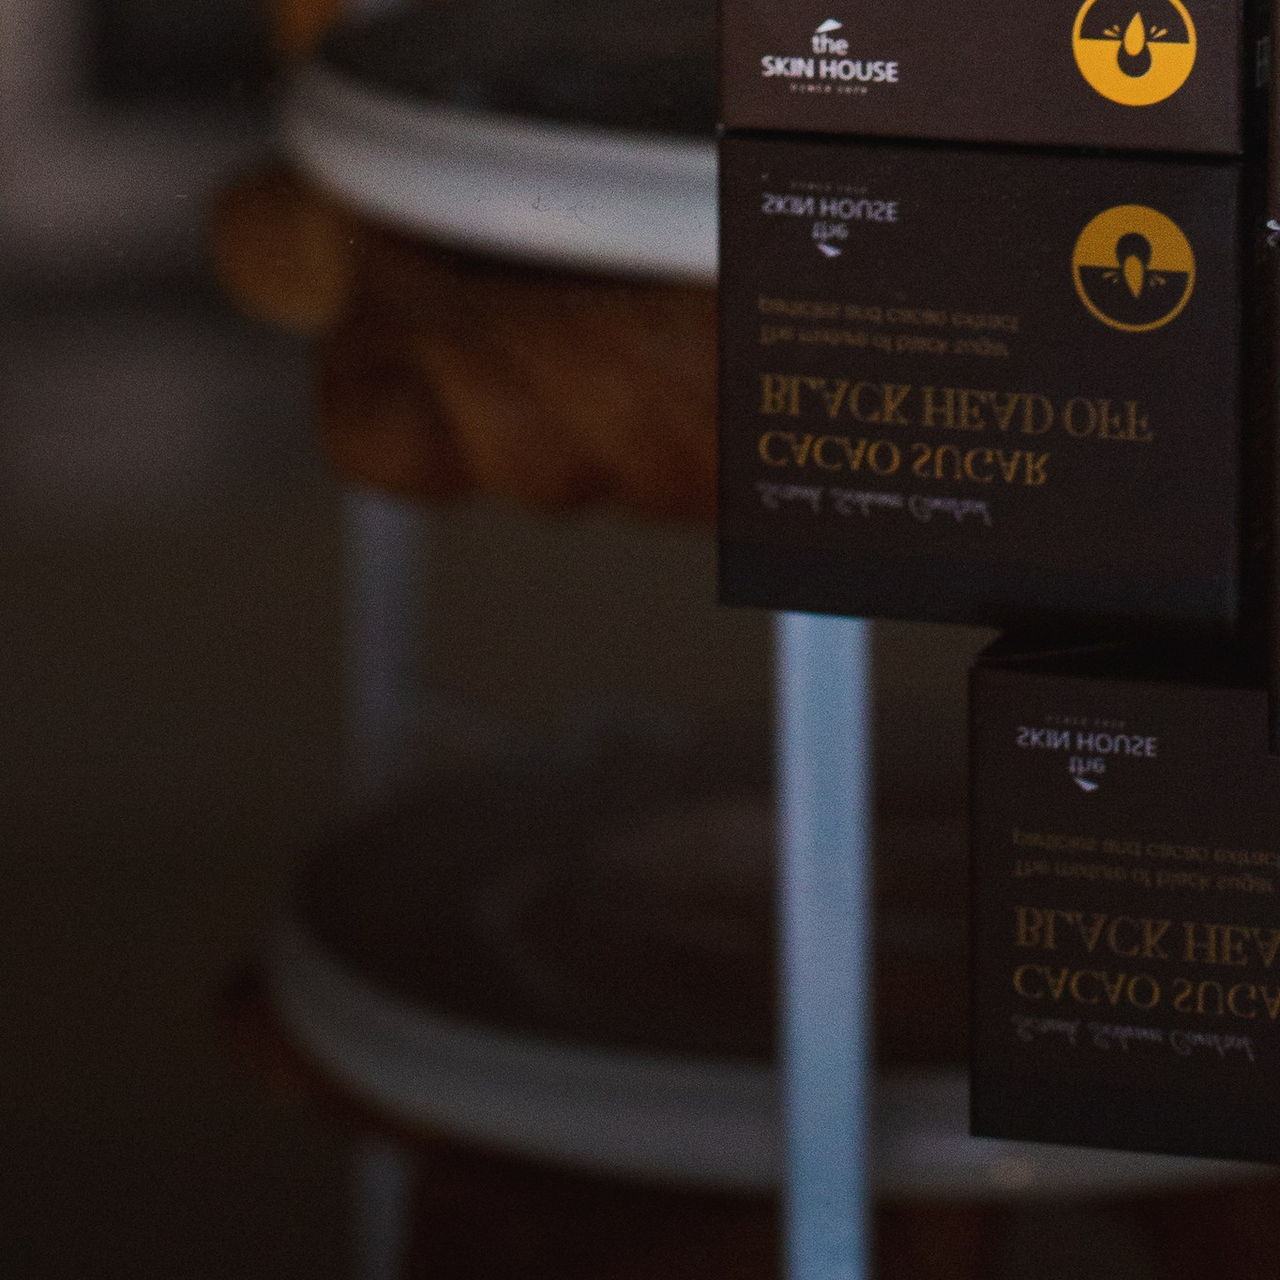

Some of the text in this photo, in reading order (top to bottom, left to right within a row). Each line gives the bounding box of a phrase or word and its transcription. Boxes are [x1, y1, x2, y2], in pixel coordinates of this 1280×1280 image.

[811, 31, 848, 55] the
[761, 56, 898, 82] SKIN HOUSE
